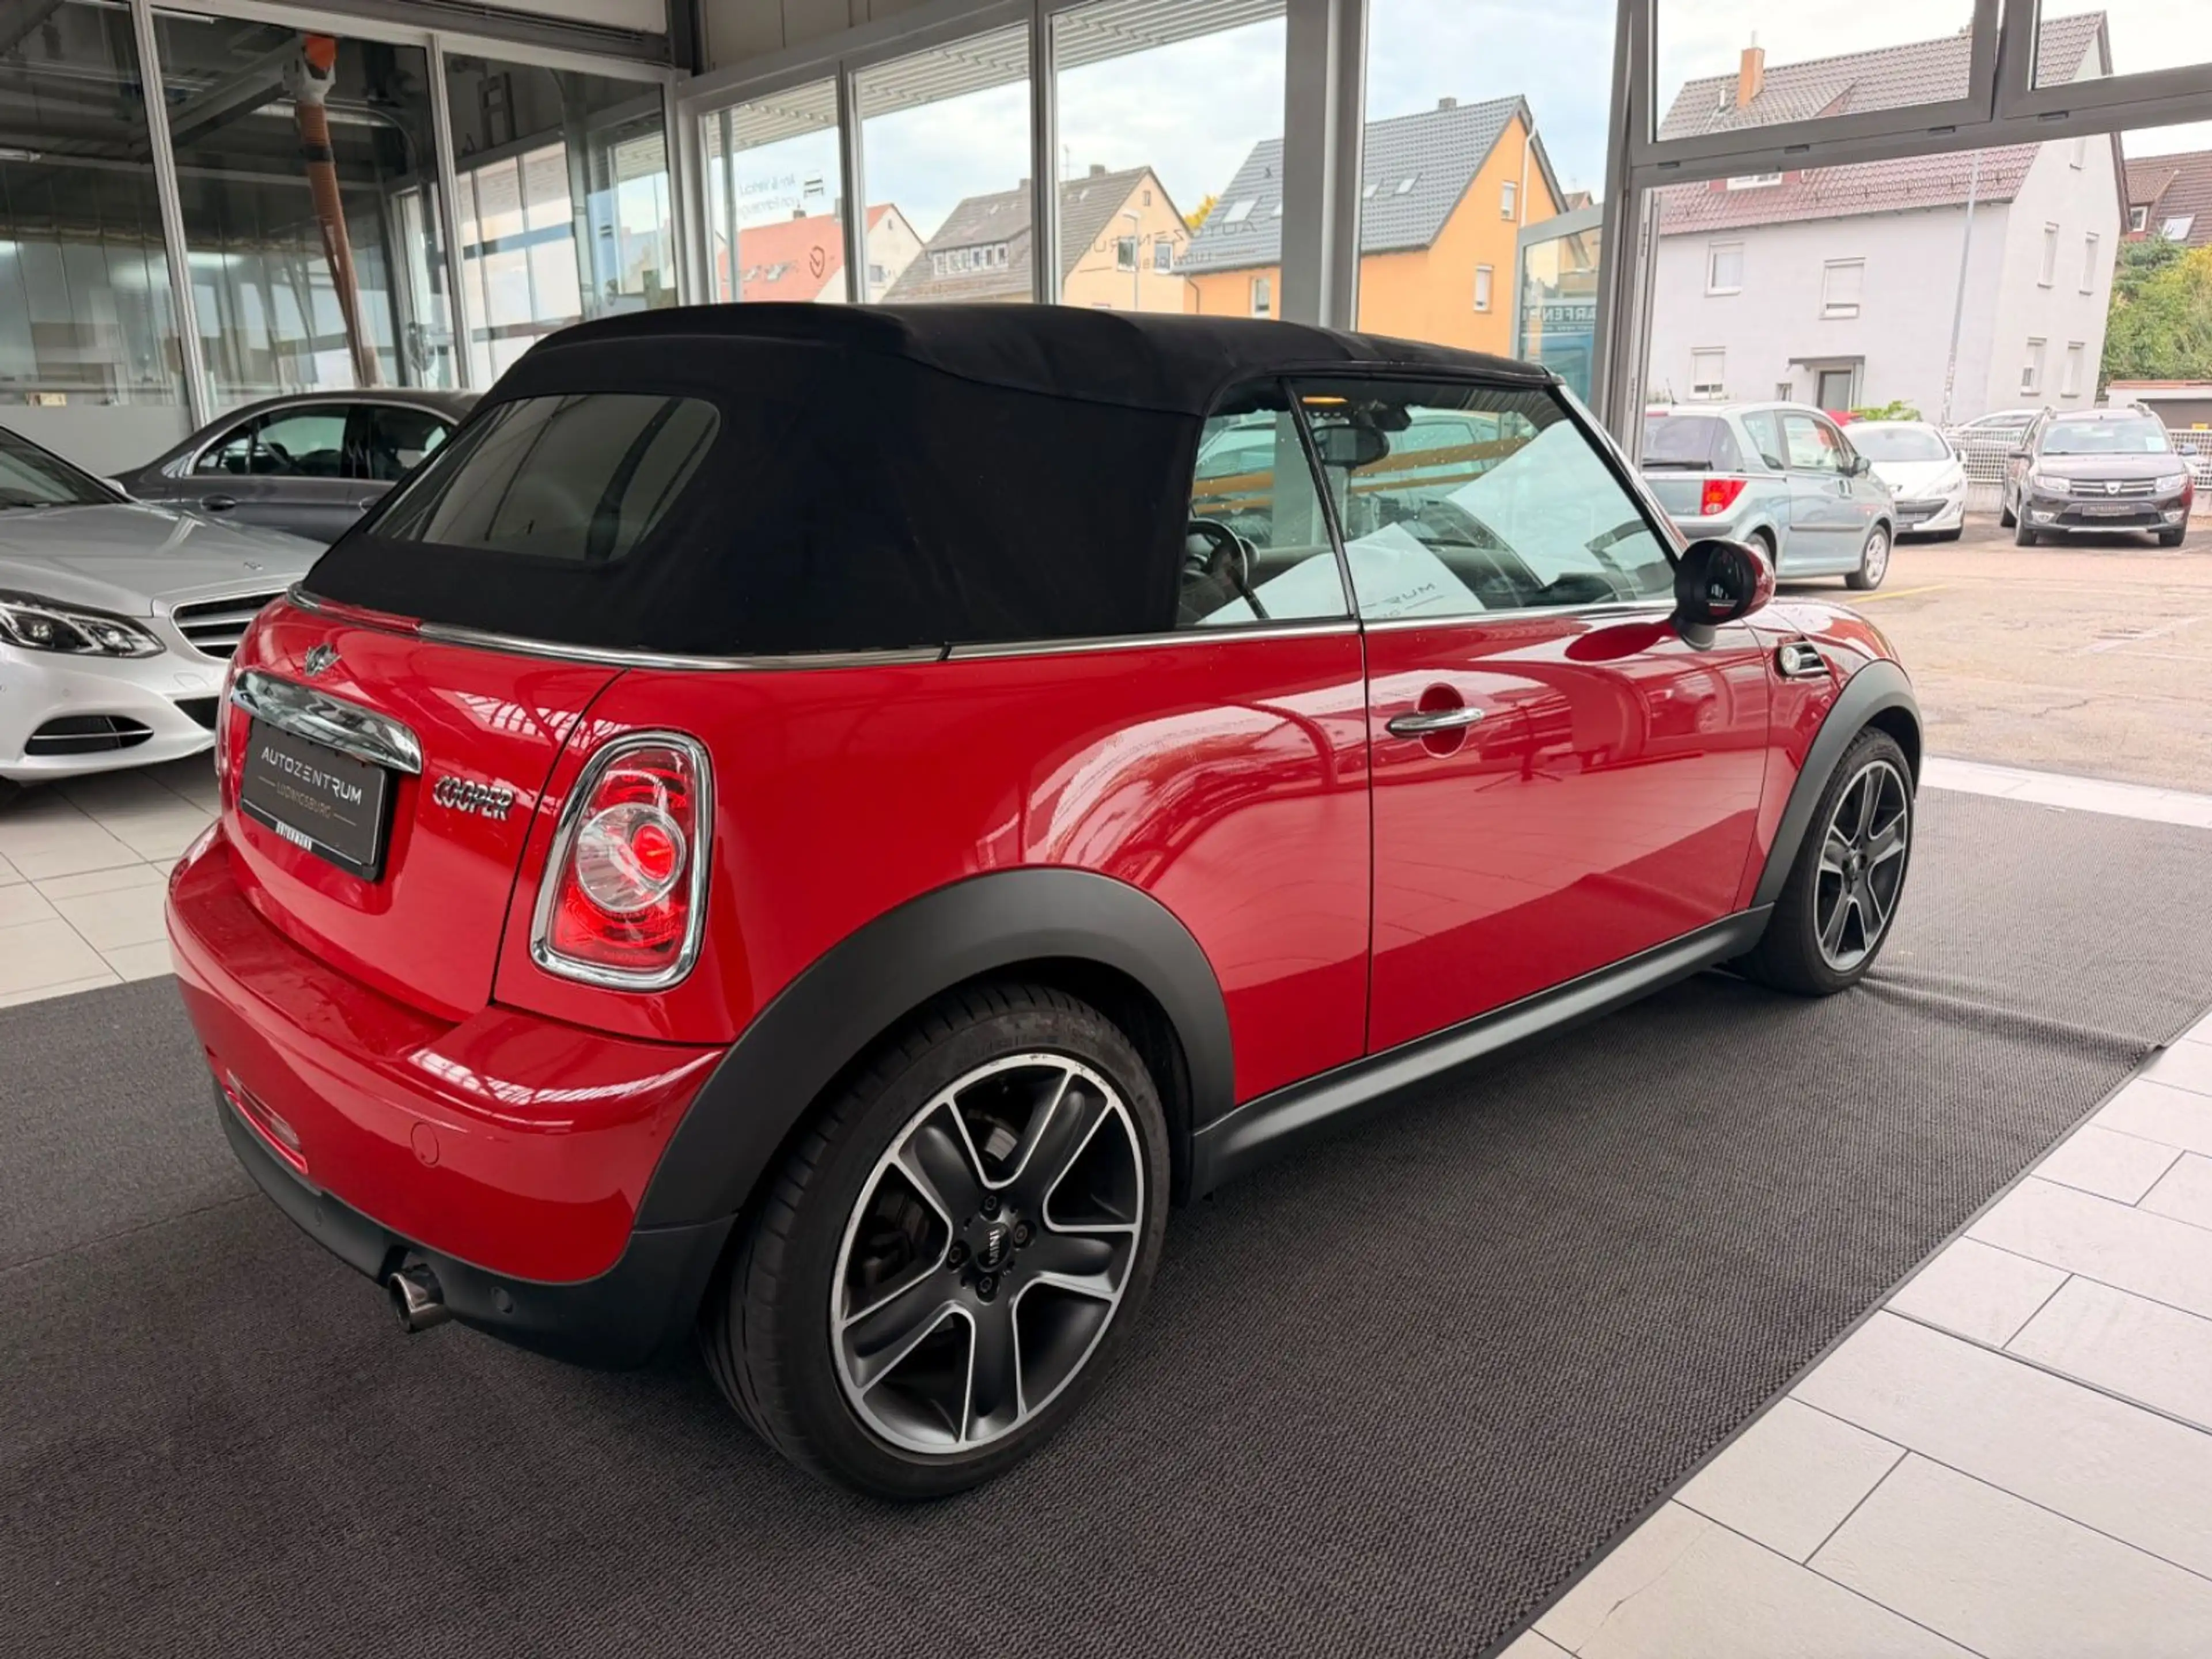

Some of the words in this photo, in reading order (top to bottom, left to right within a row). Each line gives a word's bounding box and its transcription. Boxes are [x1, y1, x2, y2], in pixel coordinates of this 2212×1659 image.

[261, 746, 363, 806] AUTOZENTRUM
[433, 775, 514, 821] COOPER
[988, 1229, 1001, 1265] MINI
